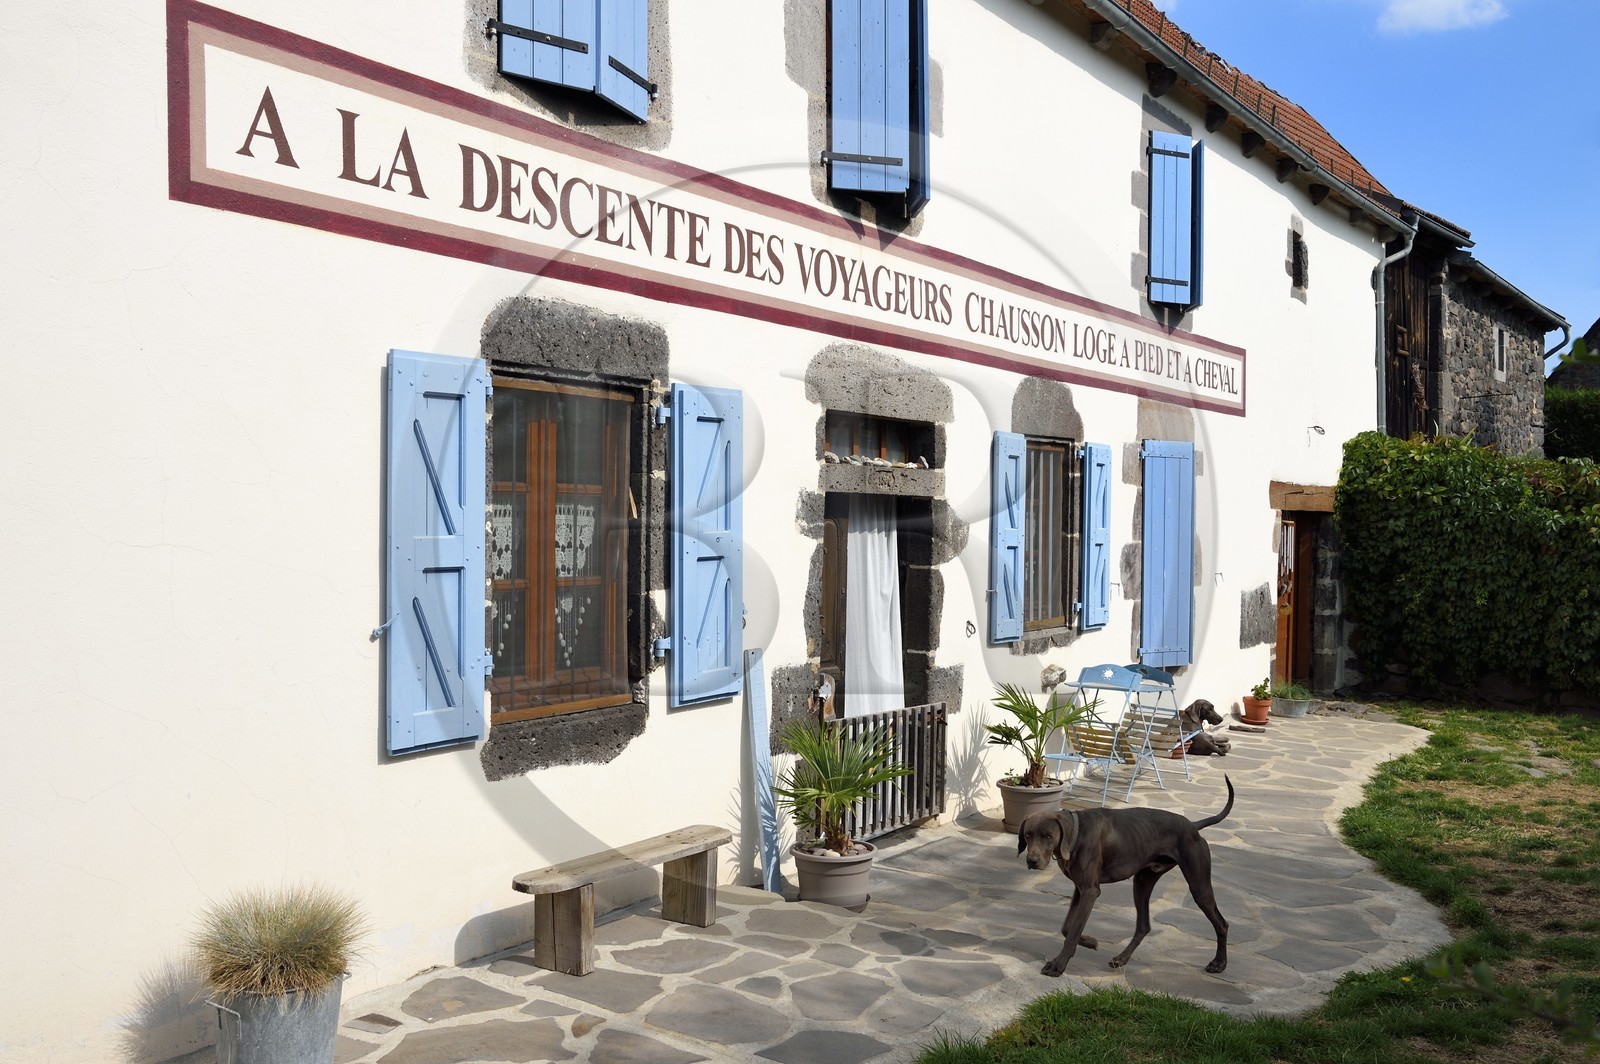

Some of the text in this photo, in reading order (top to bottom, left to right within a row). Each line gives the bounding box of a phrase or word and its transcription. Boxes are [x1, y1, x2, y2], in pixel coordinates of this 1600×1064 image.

[235, 85, 1239, 395] A LA DESCENTE DES VOYAGEURS CHAUSSON LOGE A PIED ET A CHEVAL
